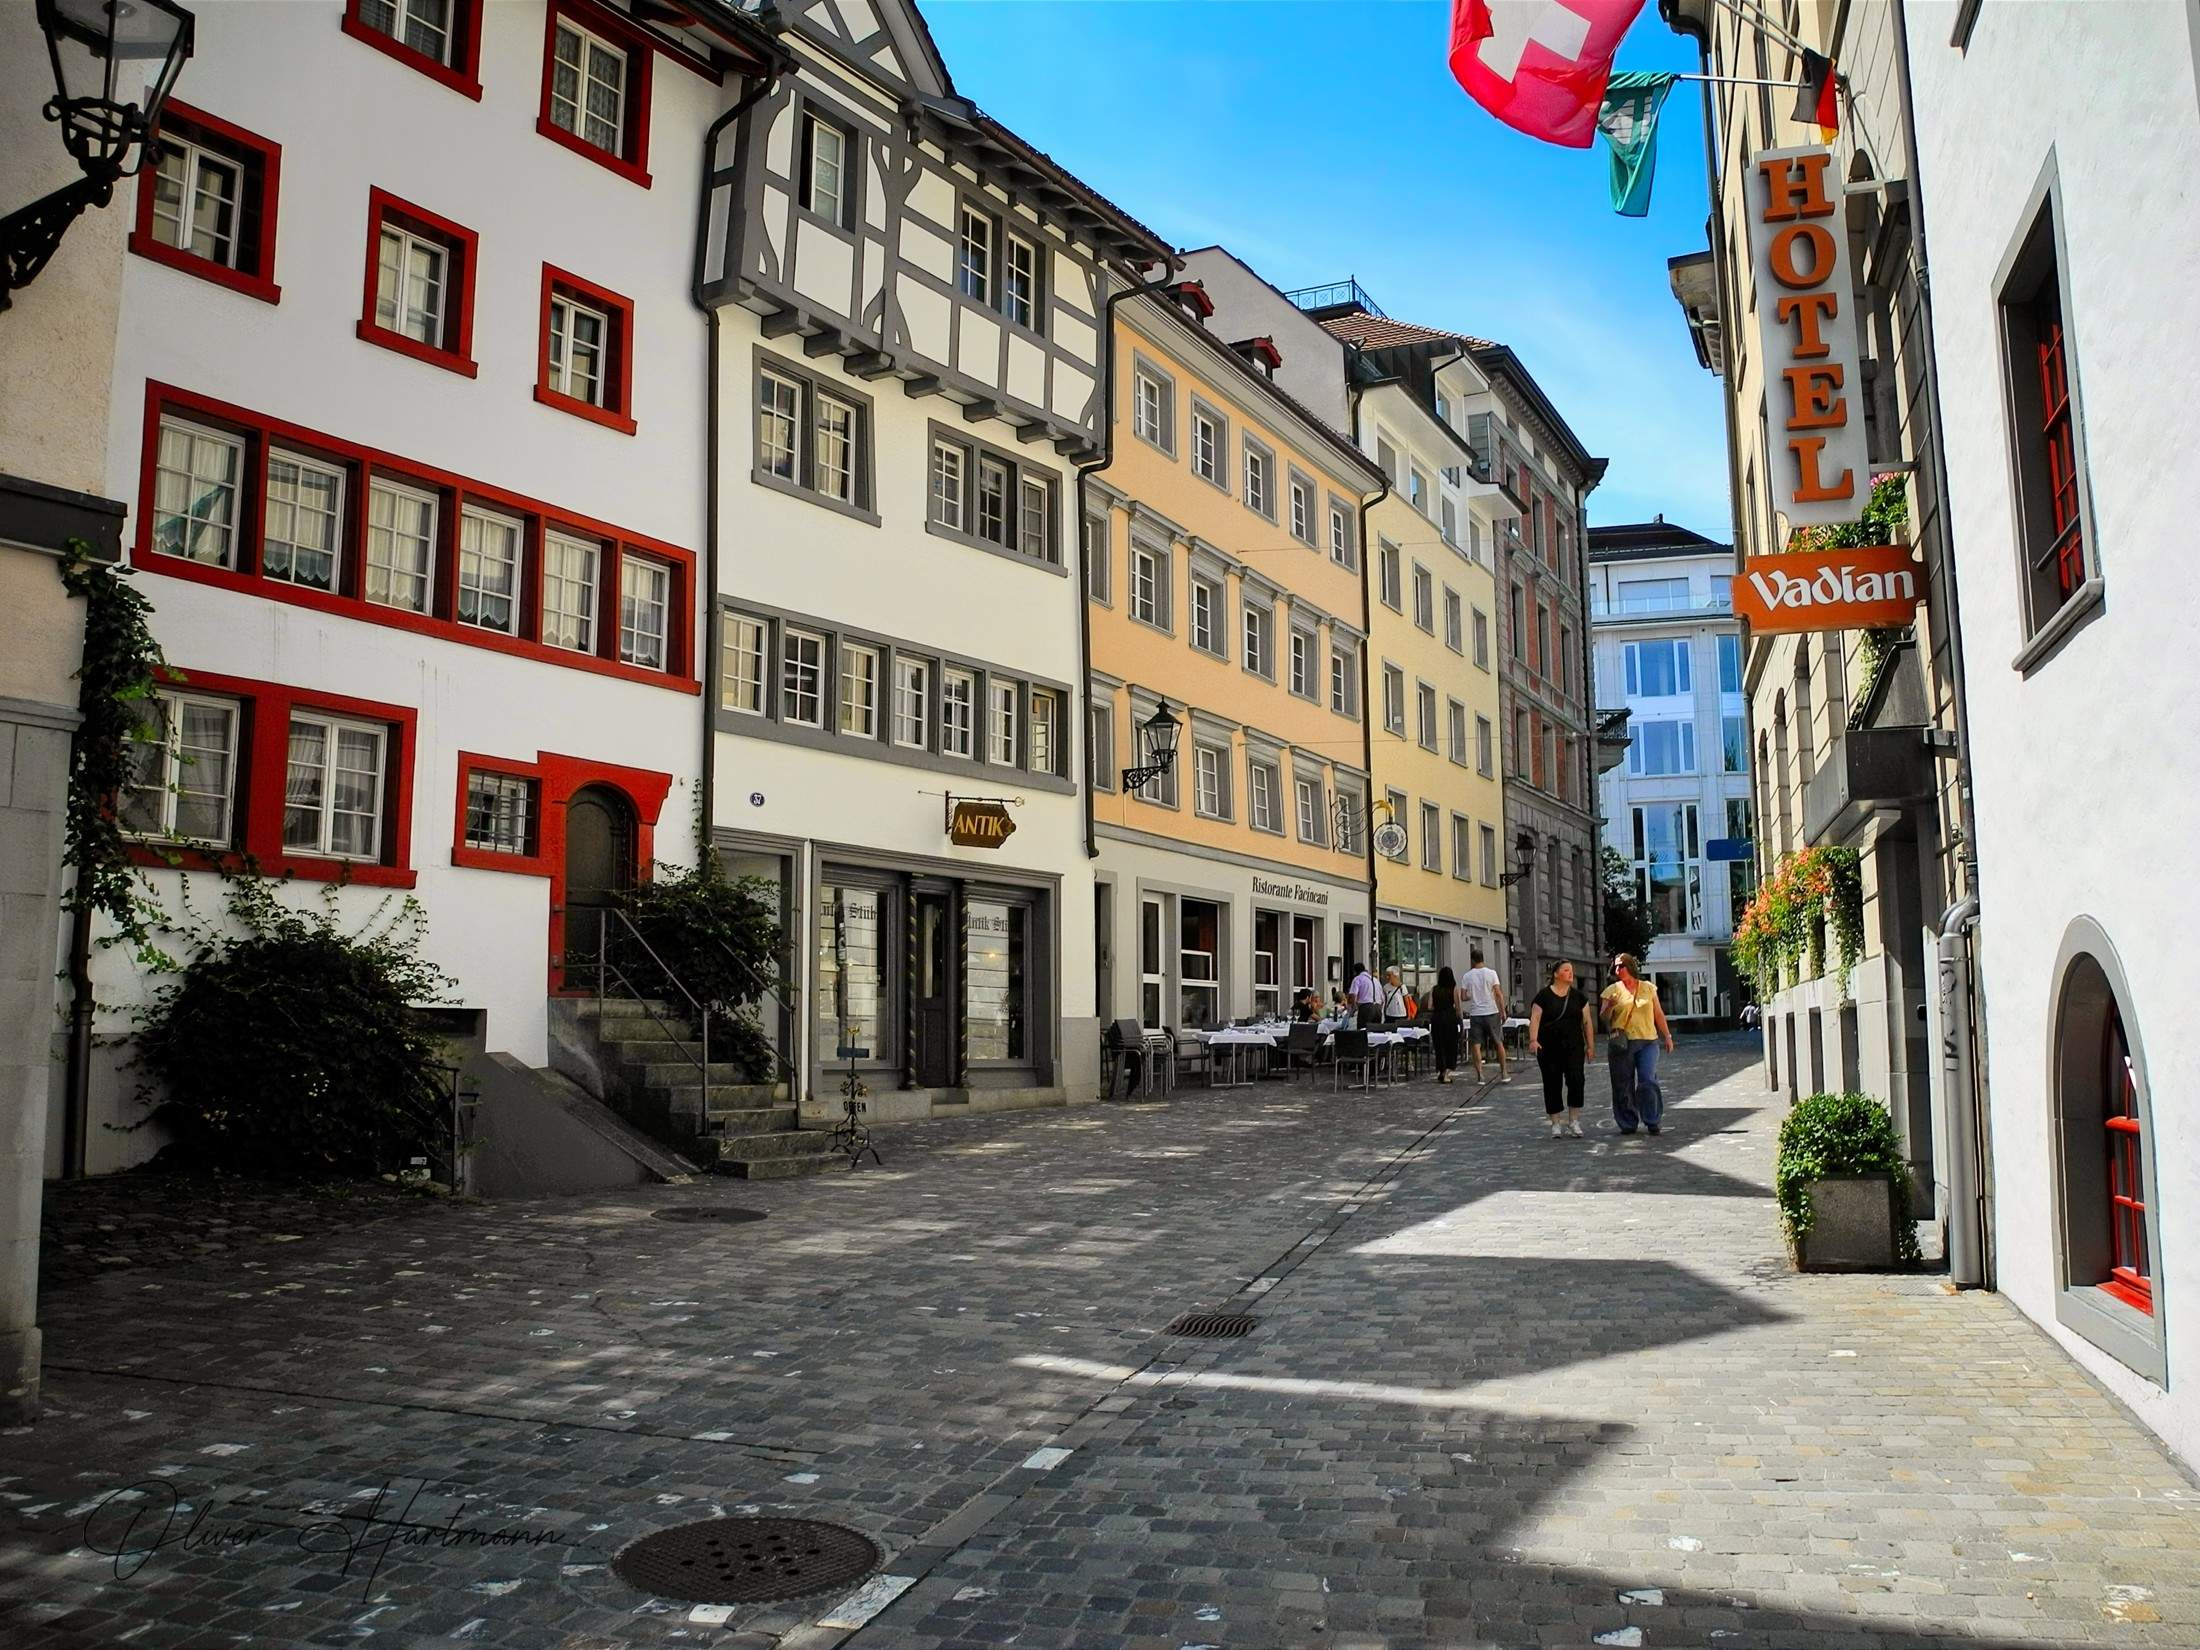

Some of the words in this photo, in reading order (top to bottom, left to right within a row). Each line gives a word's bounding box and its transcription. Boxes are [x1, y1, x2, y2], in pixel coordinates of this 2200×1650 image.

[1758, 153, 1854, 504] HOTEL
[1748, 565, 1915, 612] Vadian
[953, 814, 1005, 837] ANTIK
[1252, 876, 1293, 899] Ristorante
[1294, 884, 1329, 905] Facincani
